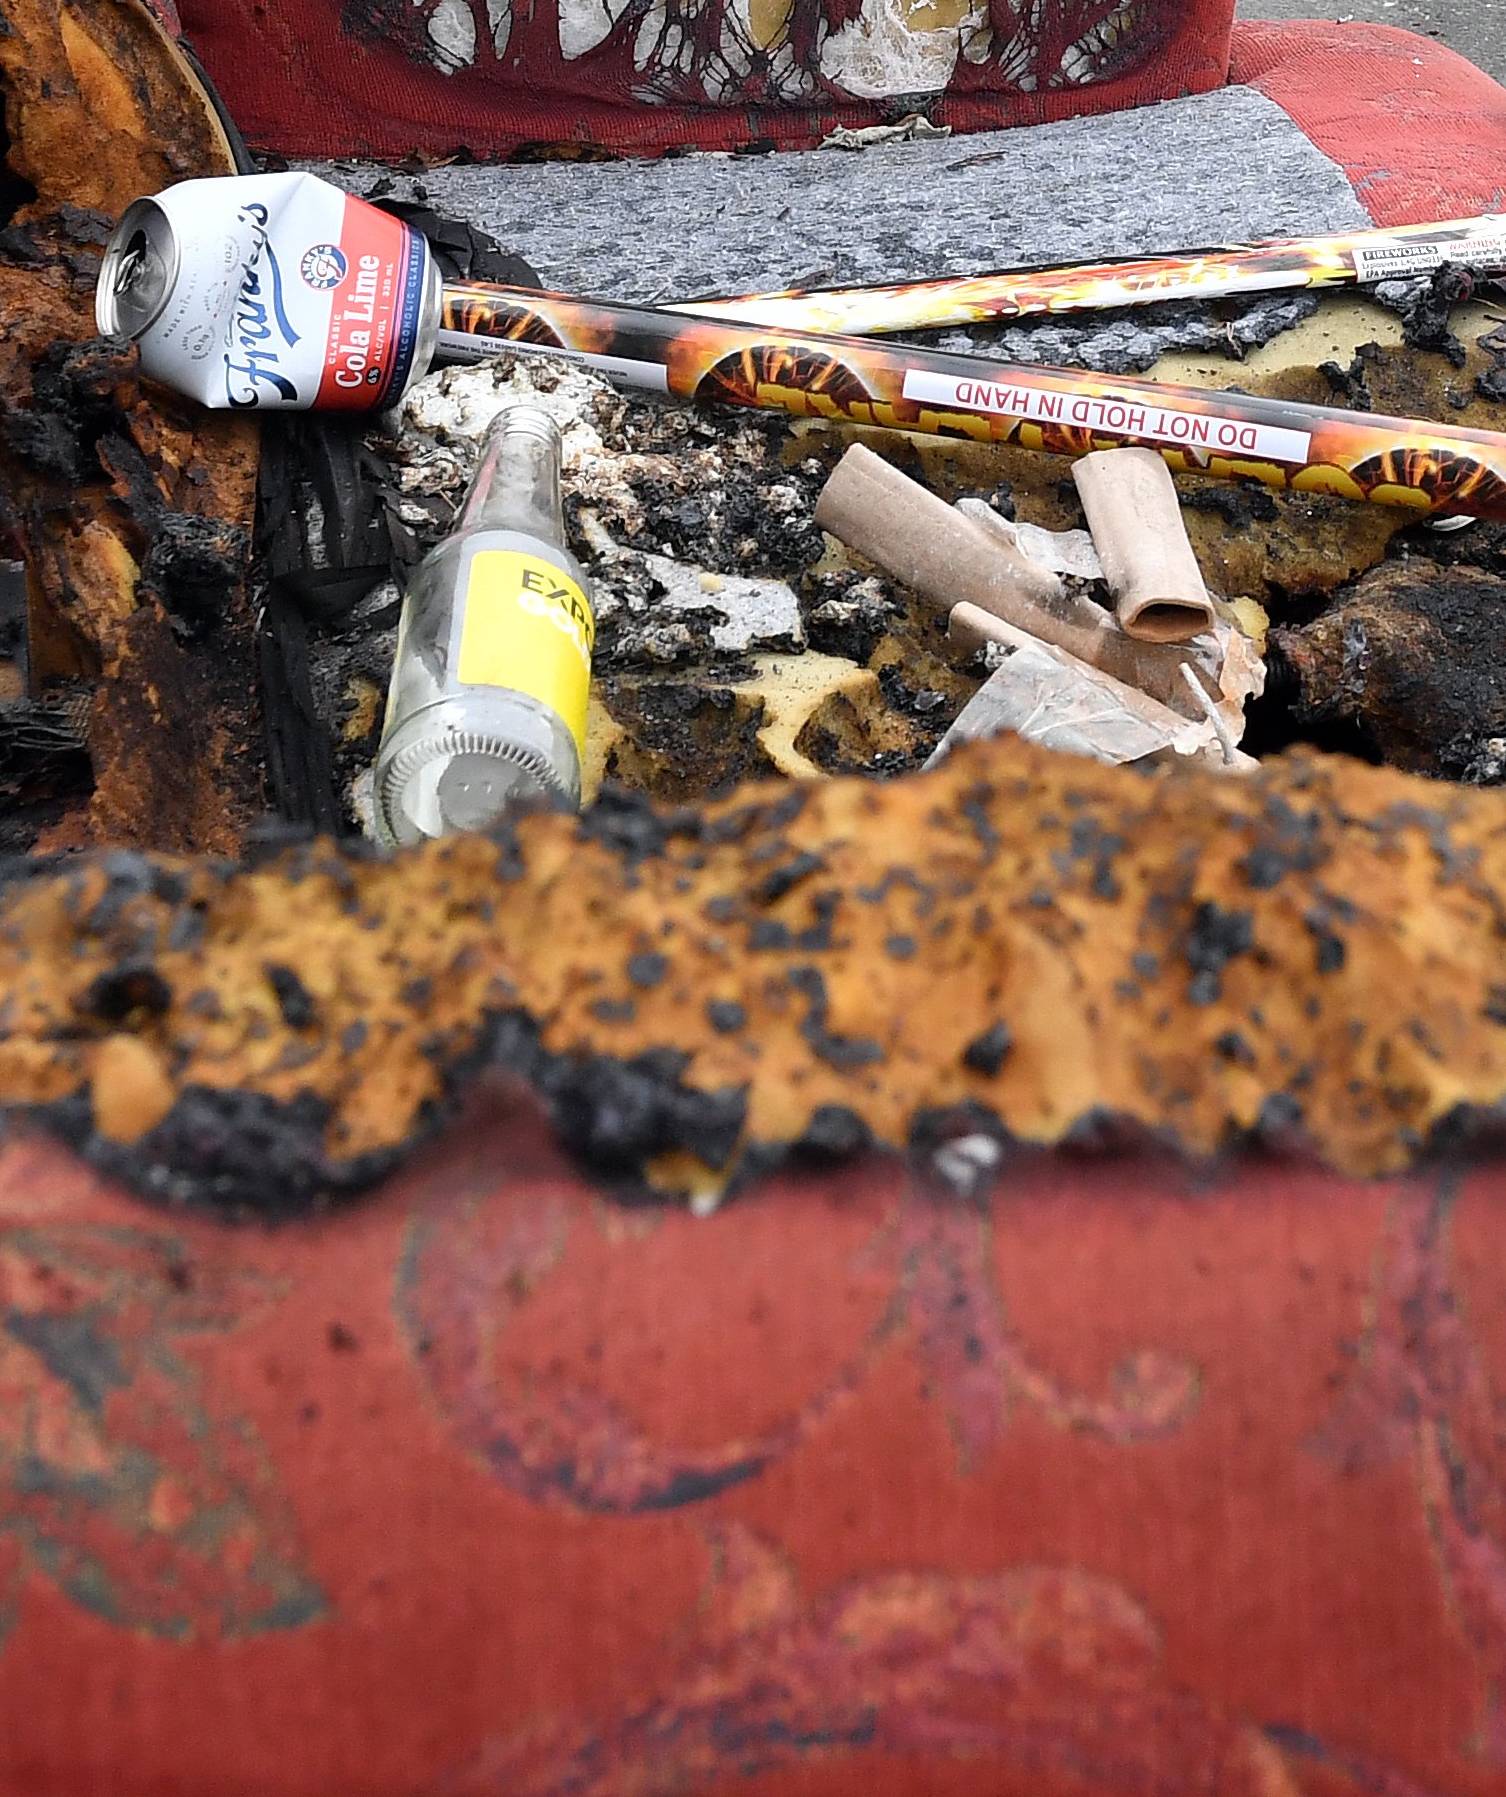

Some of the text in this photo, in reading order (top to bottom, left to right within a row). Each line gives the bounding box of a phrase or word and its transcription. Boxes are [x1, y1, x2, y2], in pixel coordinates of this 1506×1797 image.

[1364, 246, 1437, 260] FIREWORKS
[1381, 267, 1412, 277] Approval
[328, 313, 342, 365] CLASSIC
[335, 254, 380, 388] Cola Lime
[367, 368, 380, 385] 6%
[374, 319, 387, 362] ALC/VOL
[400, 291, 415, 362] ALCOHOLIC
[955, 382, 1257, 450] DO NOT HOLD IN HAND
